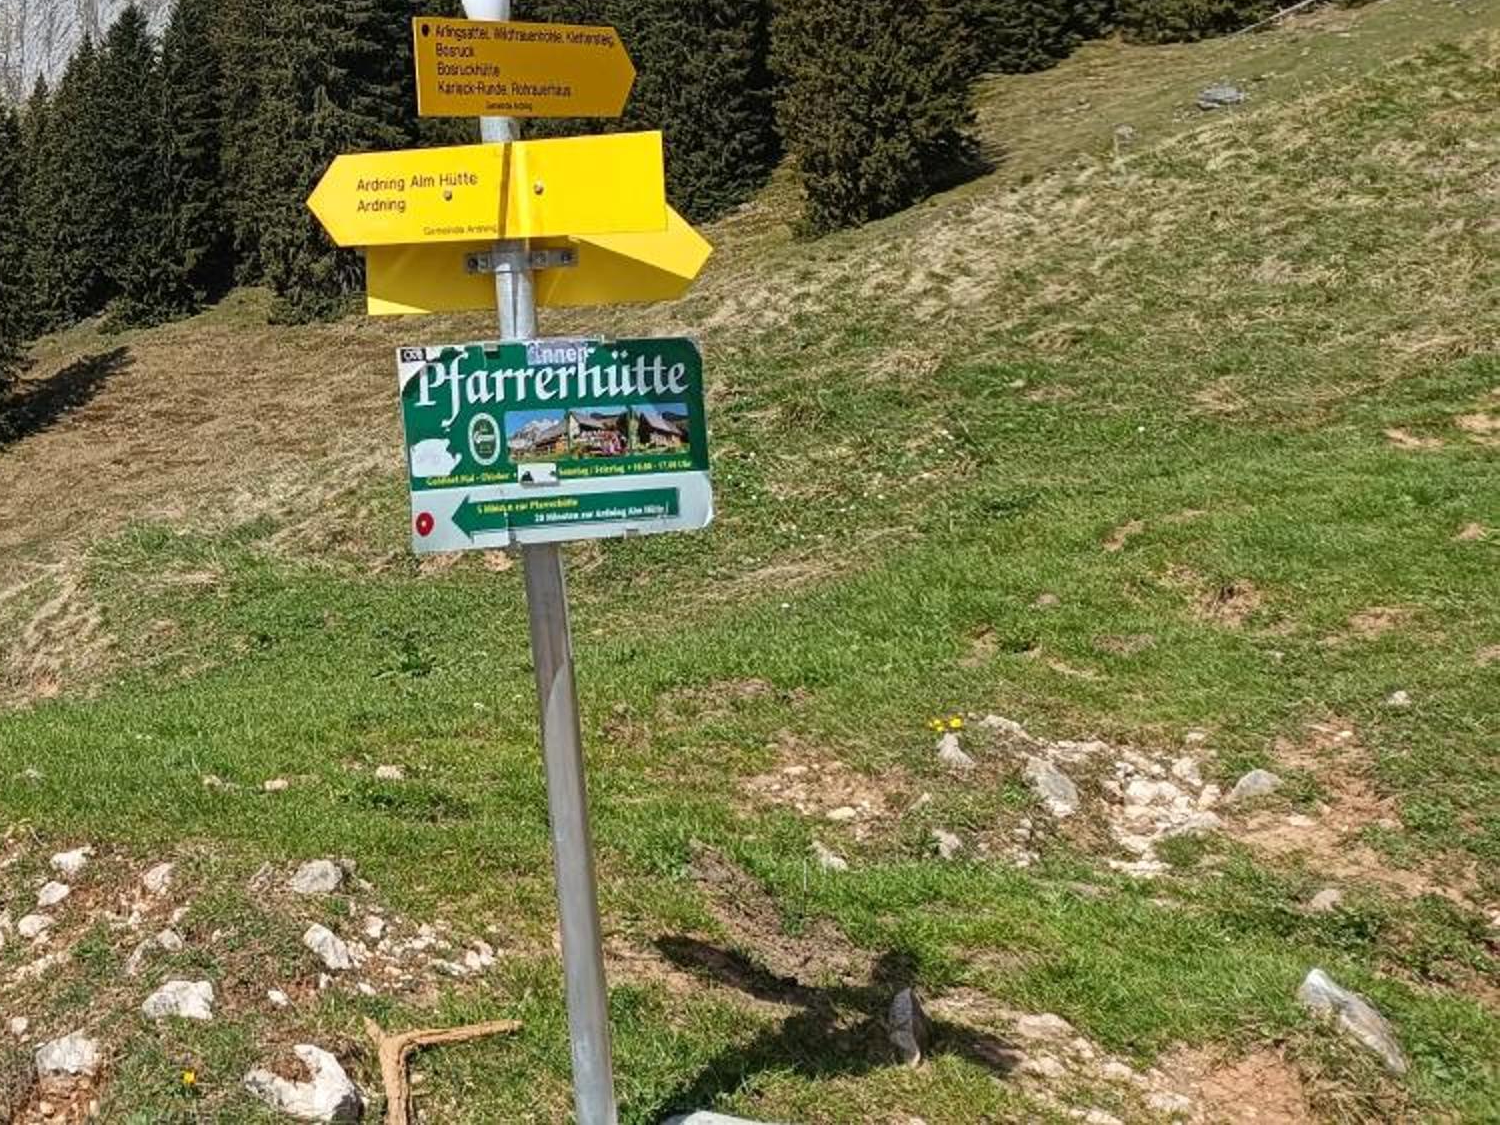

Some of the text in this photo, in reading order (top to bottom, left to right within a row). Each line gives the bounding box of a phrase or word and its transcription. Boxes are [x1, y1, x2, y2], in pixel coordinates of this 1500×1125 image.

[436, 43, 475, 57] Bosruck
[356, 172, 478, 191] Ardning Alm Hütte
[357, 199, 406, 213] Ardning
[423, 224, 497, 236] Gemeinde Ardning
[414, 349, 690, 429] Pfarrerhütte
